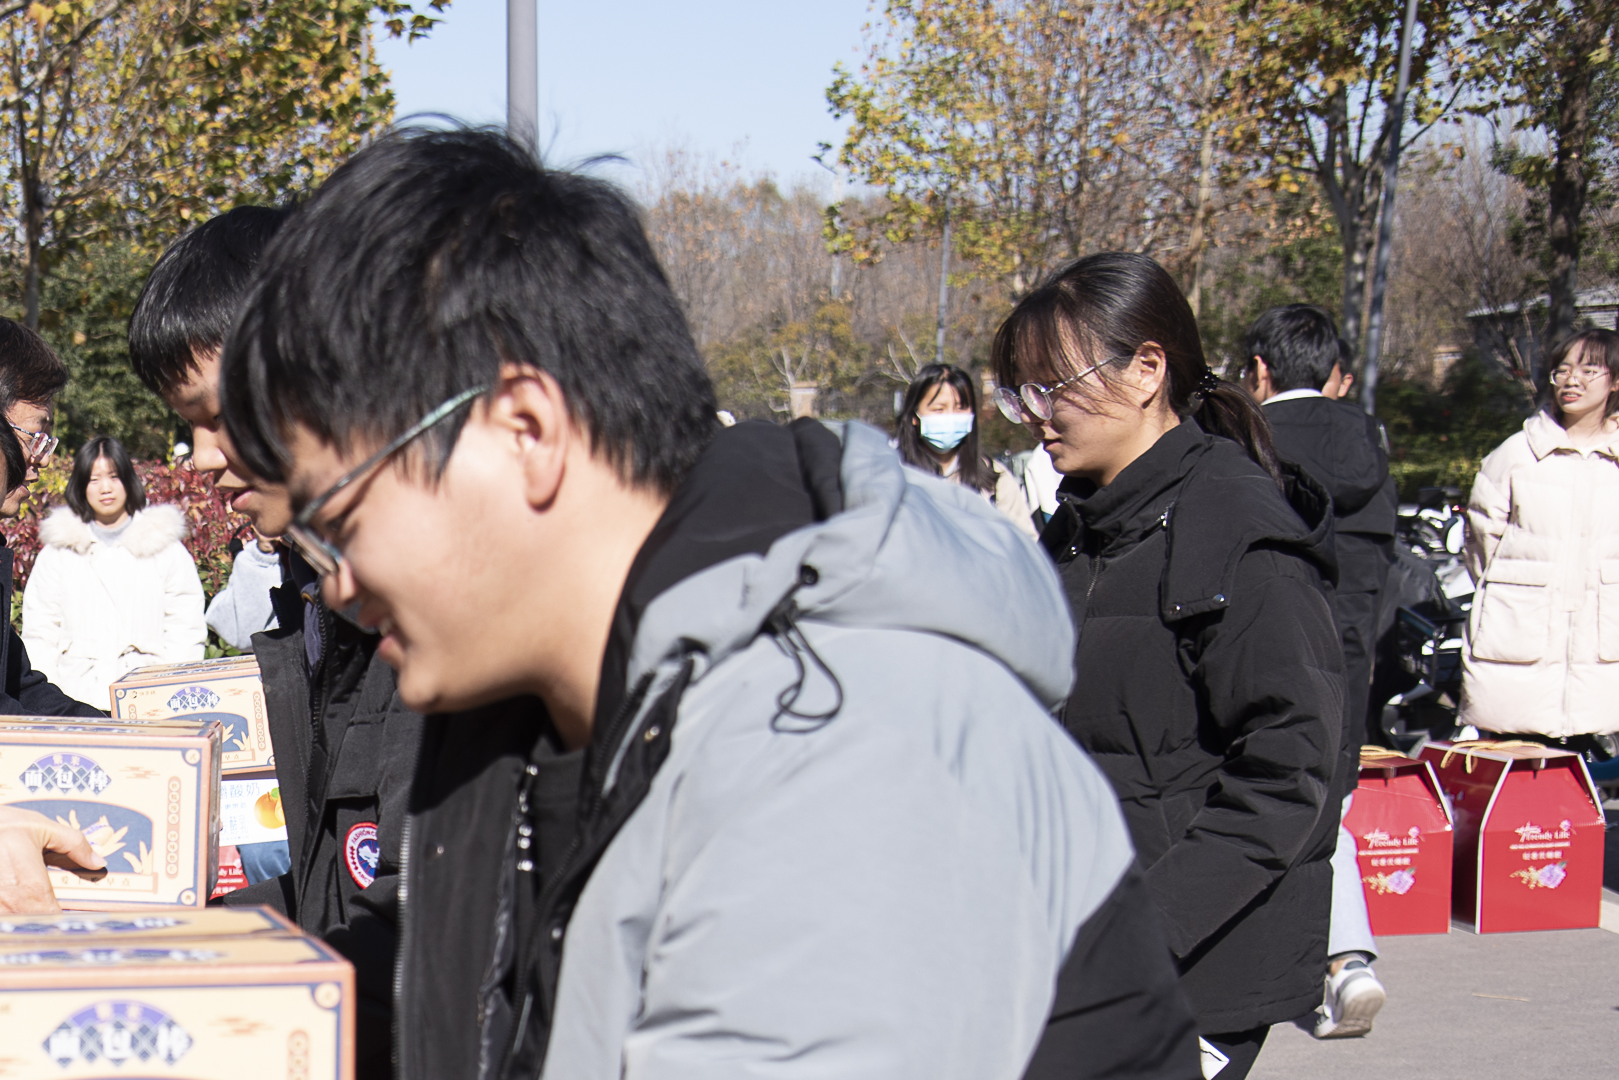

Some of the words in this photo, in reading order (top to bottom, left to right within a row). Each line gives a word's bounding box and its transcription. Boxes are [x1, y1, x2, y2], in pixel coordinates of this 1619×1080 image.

[169, 693, 220, 710] 面包棒
[23, 768, 109, 791] 面包棒
[49, 1024, 190, 1063] 面包棒
